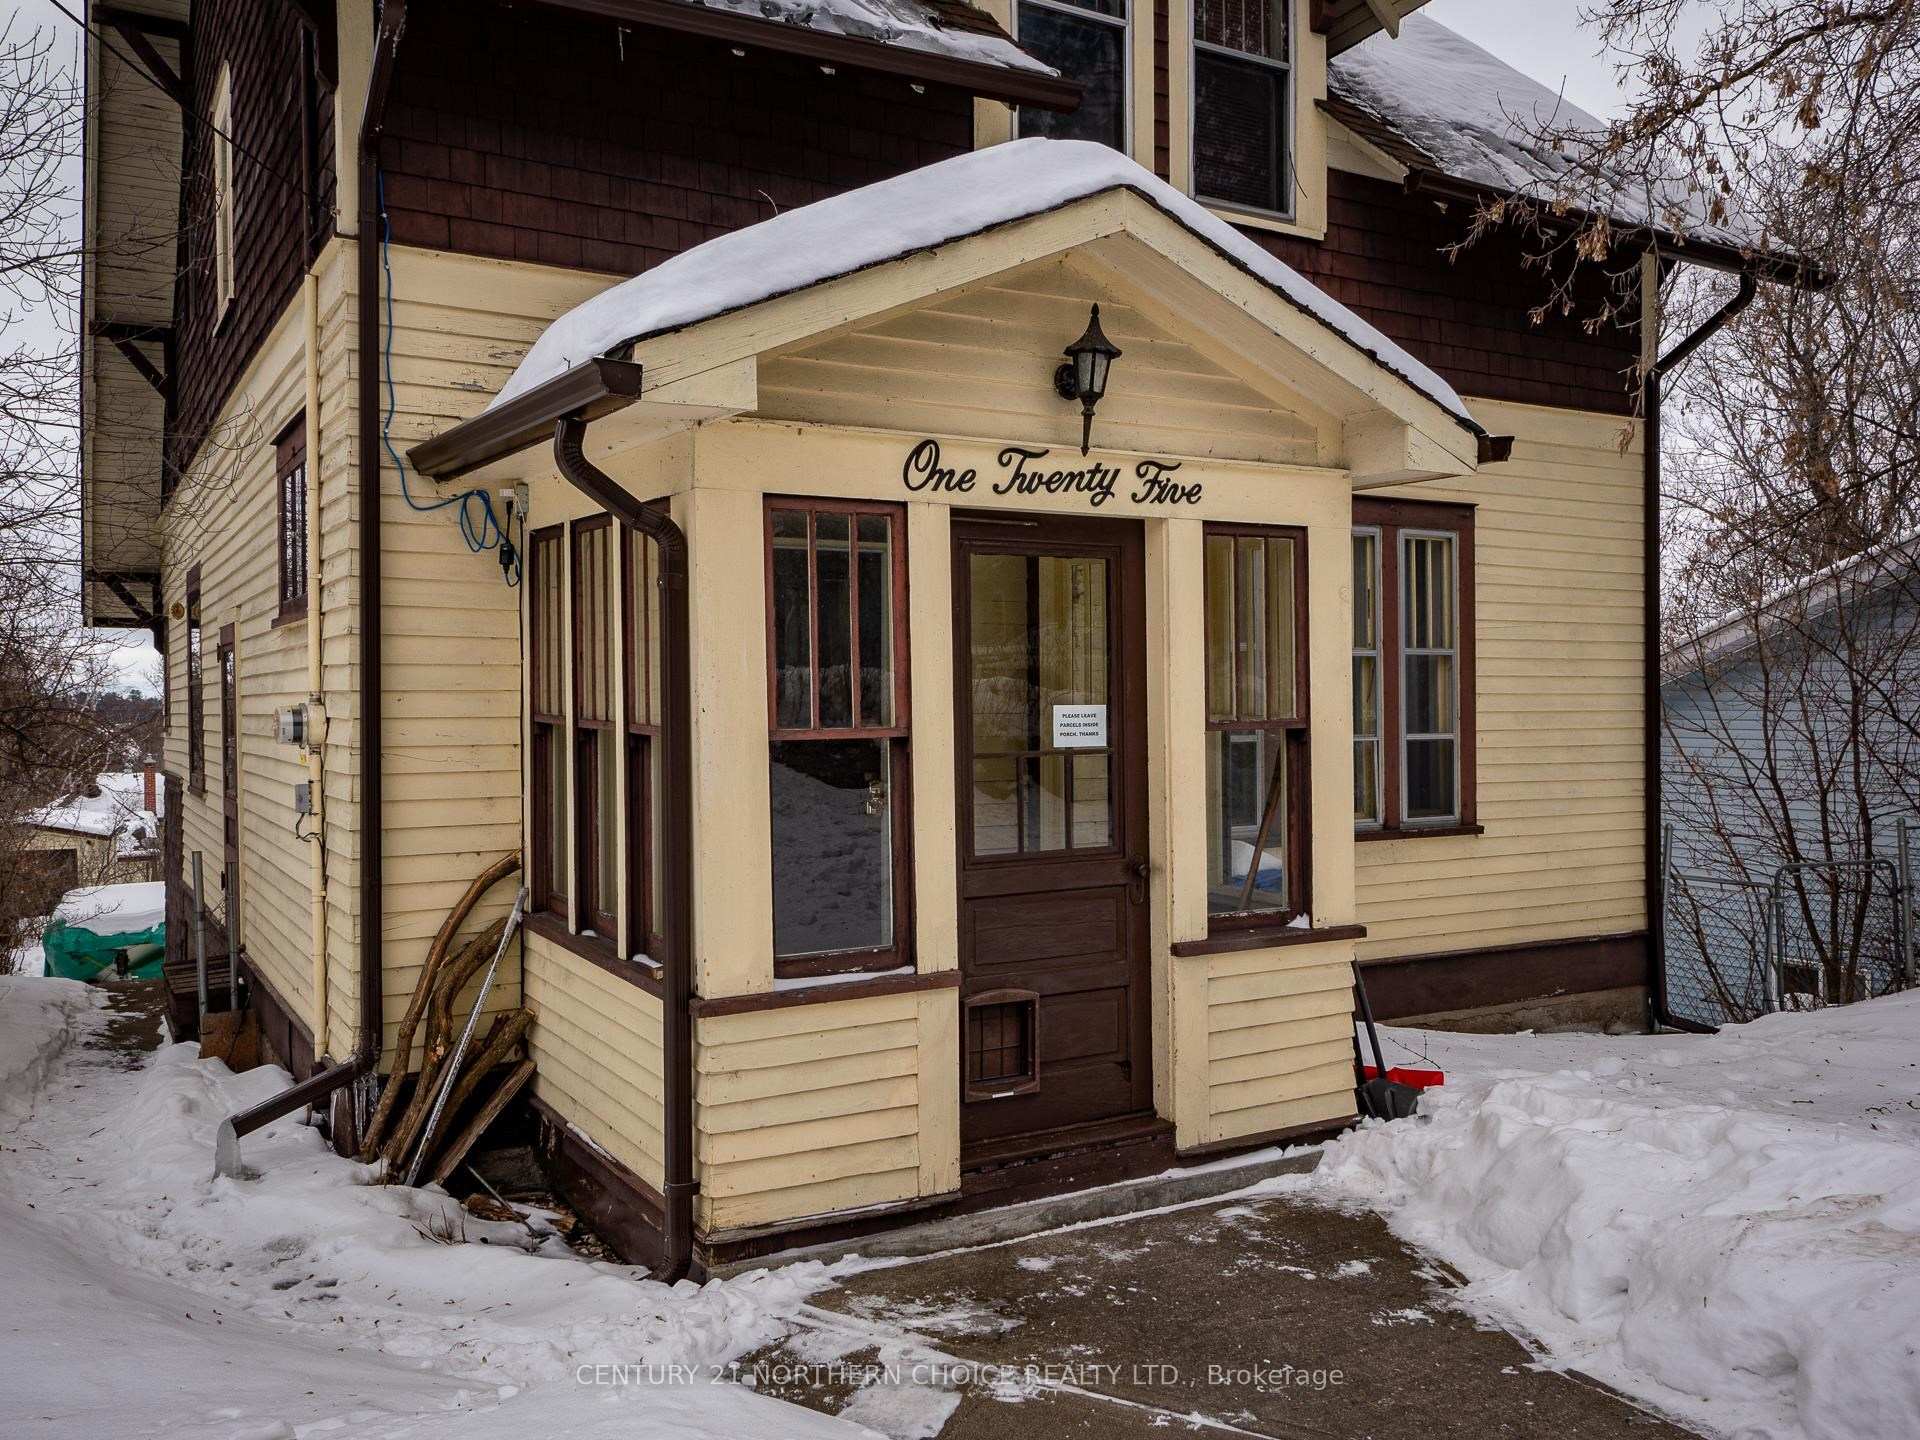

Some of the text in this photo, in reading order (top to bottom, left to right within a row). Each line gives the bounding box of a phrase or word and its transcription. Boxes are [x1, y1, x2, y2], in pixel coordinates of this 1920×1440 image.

[902, 439, 1202, 507] One Twenty Five
